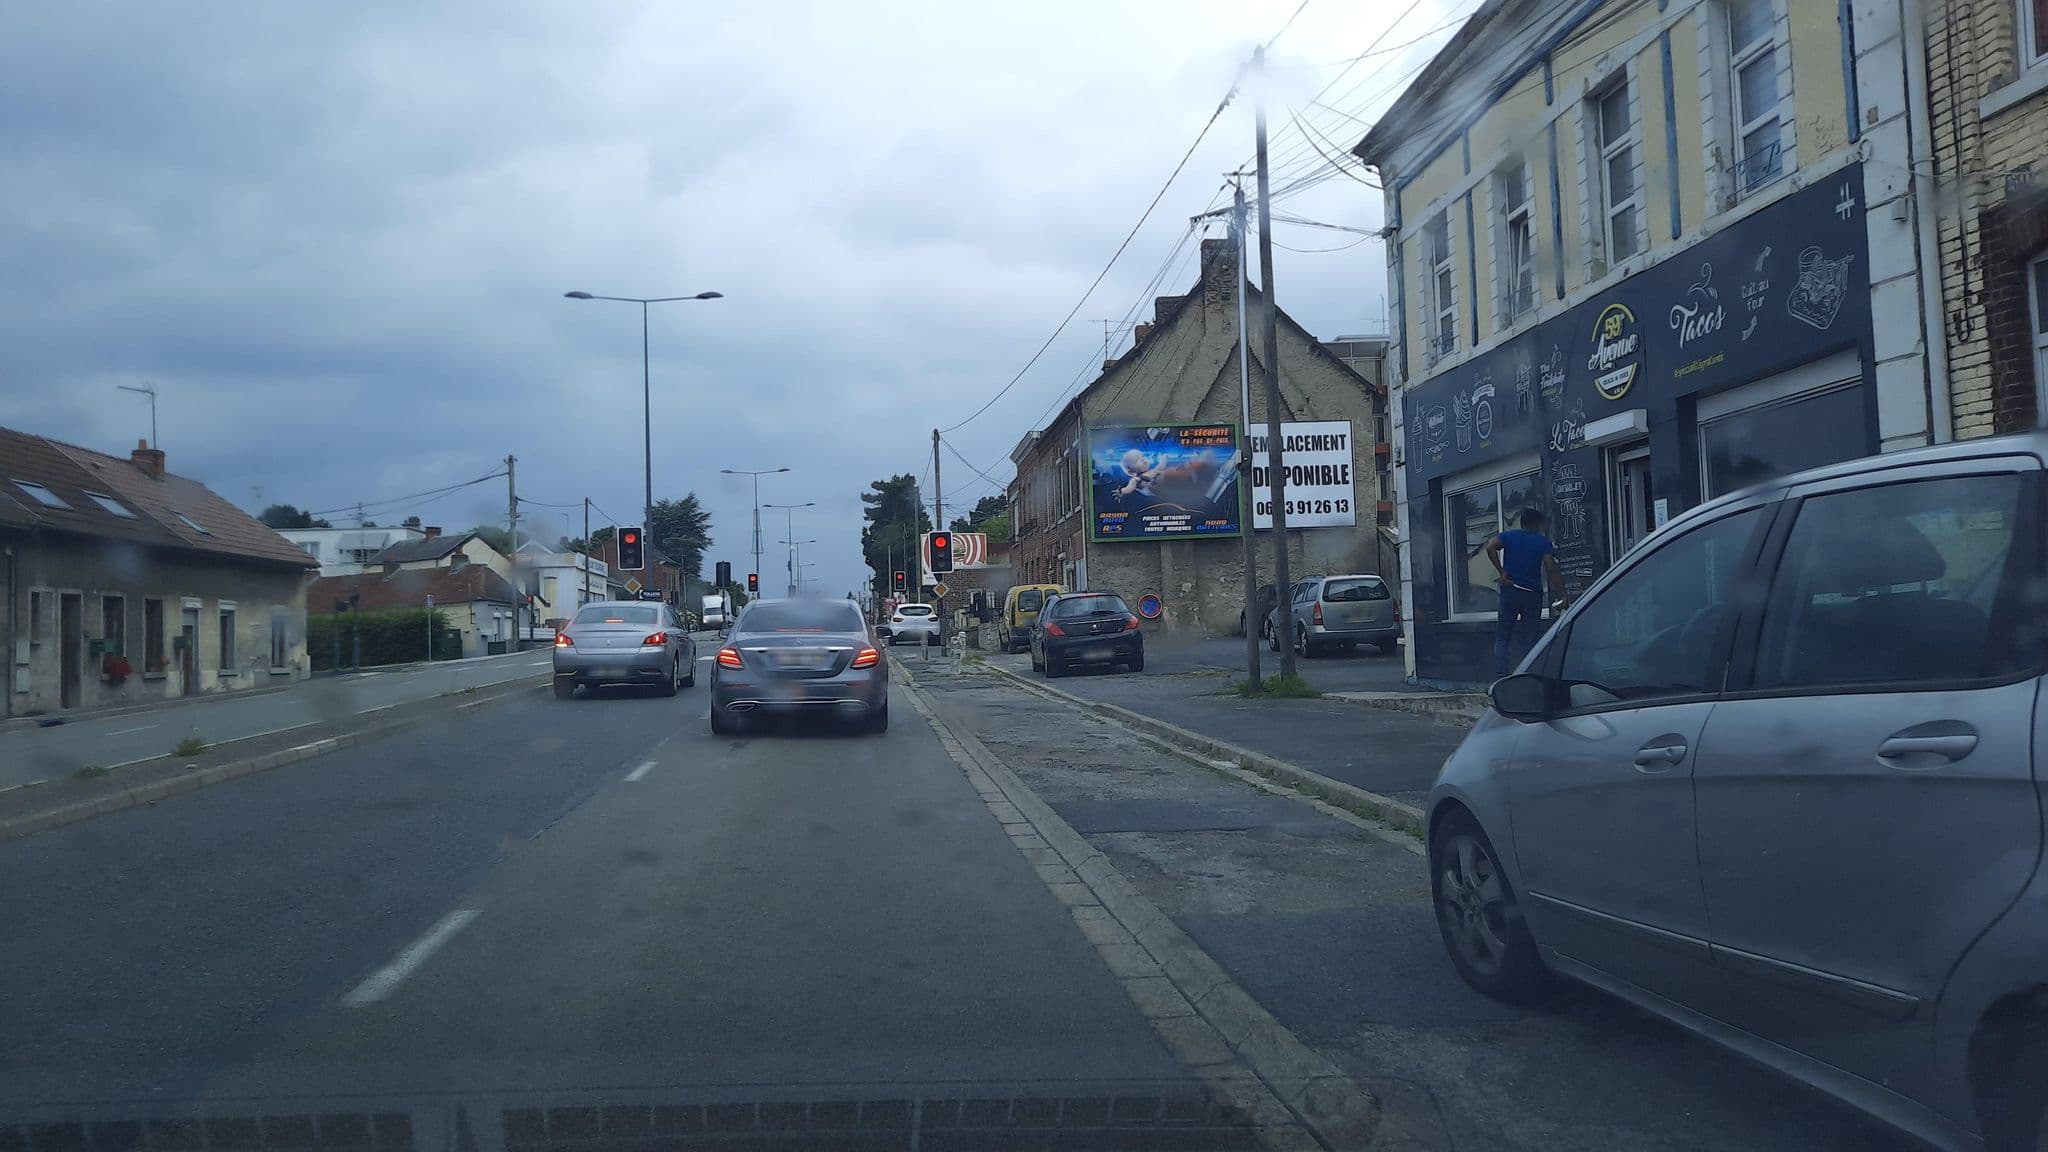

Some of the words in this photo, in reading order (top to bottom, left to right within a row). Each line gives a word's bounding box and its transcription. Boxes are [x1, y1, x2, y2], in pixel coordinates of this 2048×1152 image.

[1669, 301, 1727, 349] Tacos
[1253, 434, 1346, 453] EMLACEMENT
[1253, 464, 1349, 487] DIPONIBLE
[1297, 500, 1311, 514] 91
[1315, 500, 1331, 514] 26
[1335, 499, 1348, 513] 13
